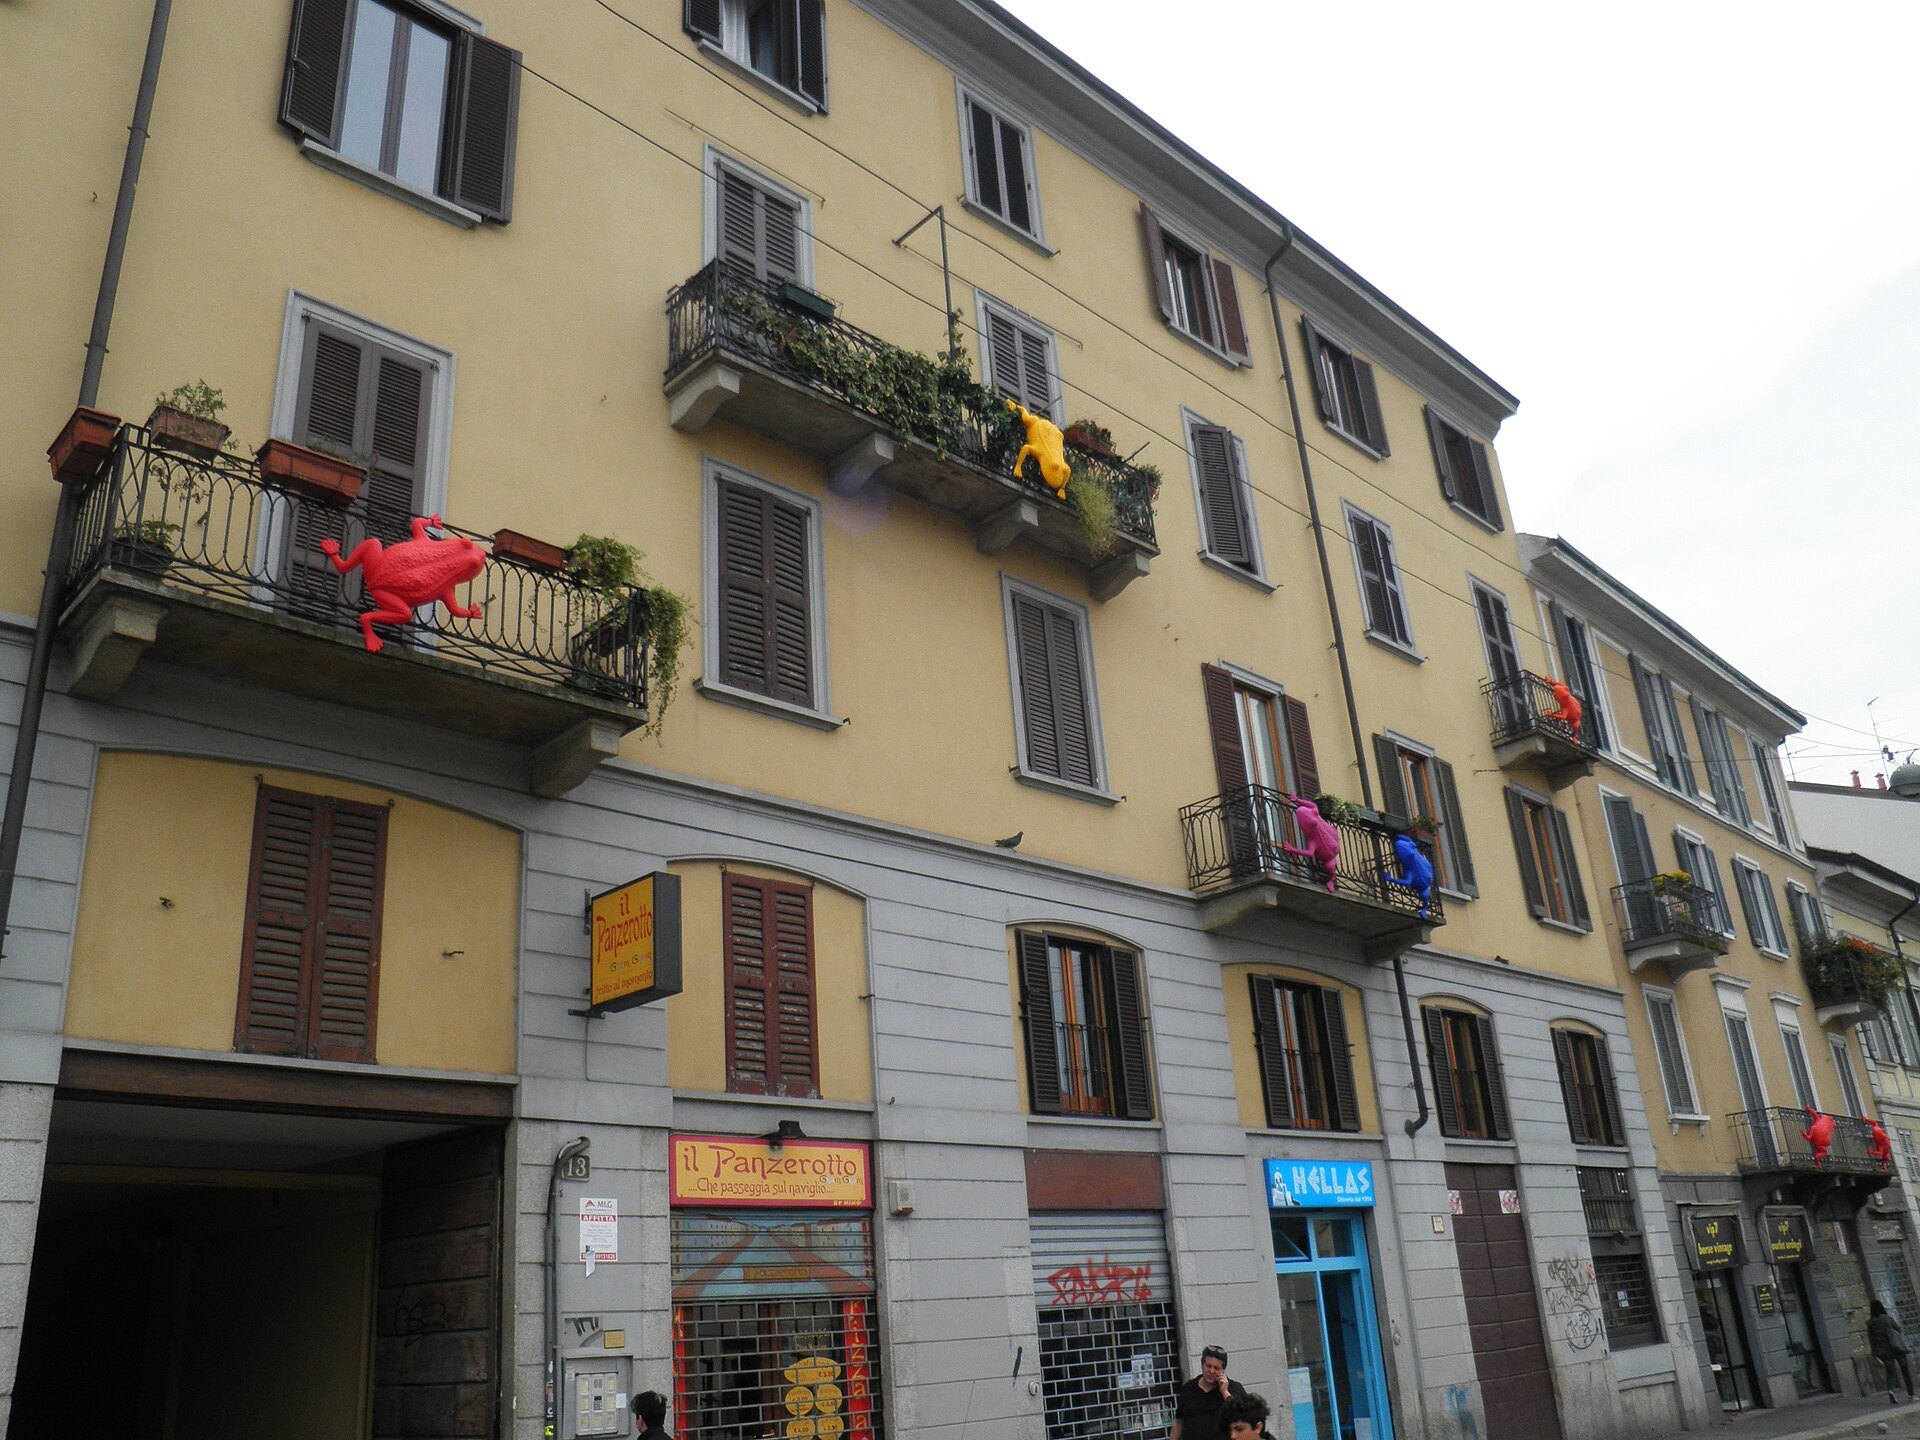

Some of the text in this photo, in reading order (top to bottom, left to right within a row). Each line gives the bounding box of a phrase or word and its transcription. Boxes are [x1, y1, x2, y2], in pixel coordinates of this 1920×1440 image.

[619, 893, 630, 917] il
[596, 904, 653, 965] Panzerotto
[567, 1157, 586, 1178] 13
[683, 1145, 857, 1180] il Panzerotto
[721, 1180, 770, 1197] passeggia
[772, 1180, 786, 1195] sul
[1292, 1166, 1370, 1194] HELLAS
